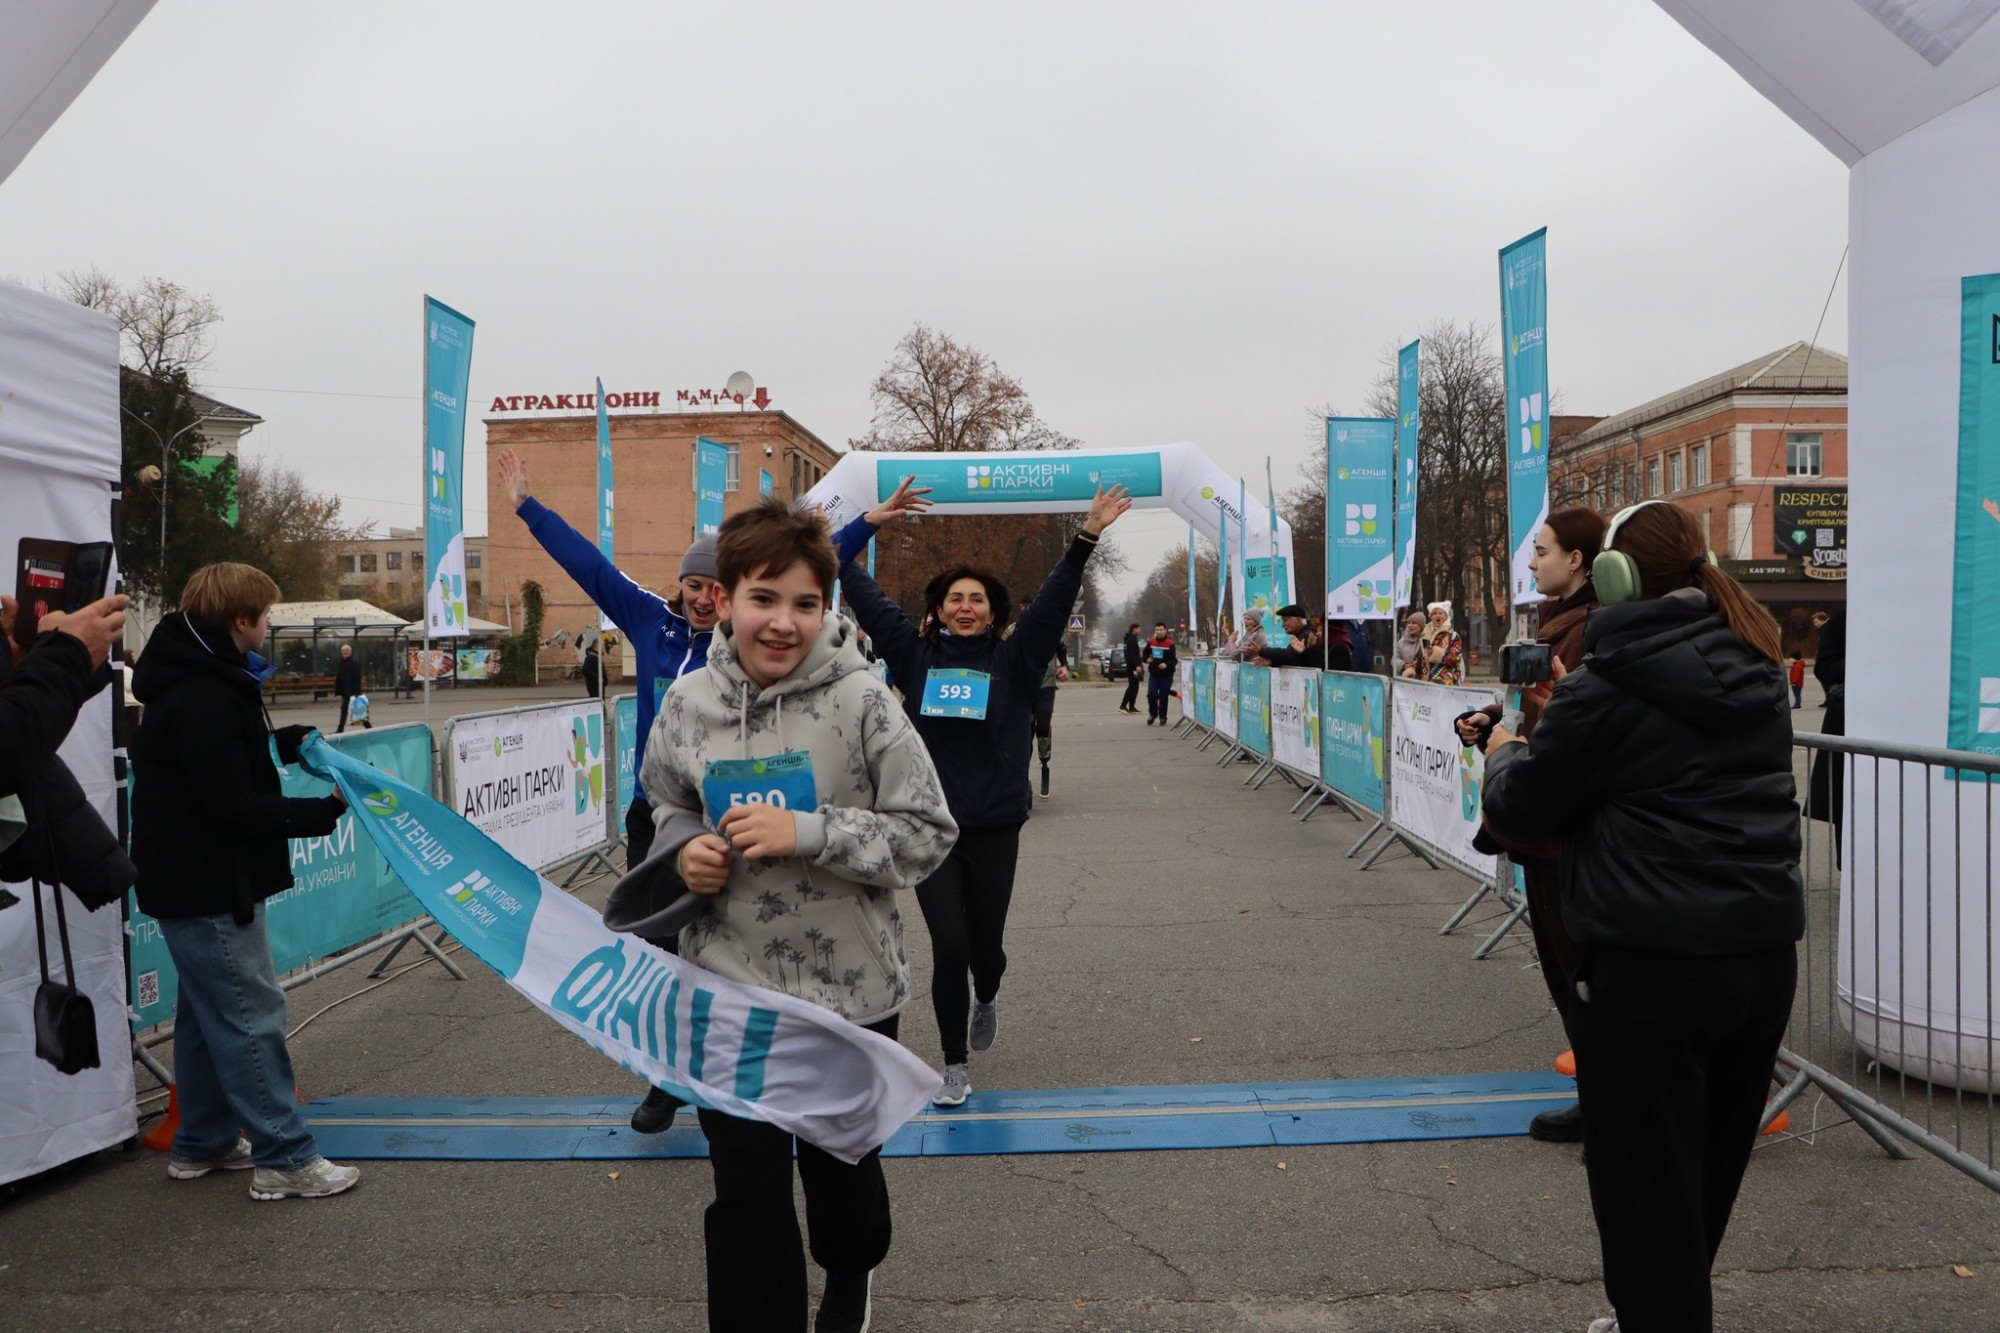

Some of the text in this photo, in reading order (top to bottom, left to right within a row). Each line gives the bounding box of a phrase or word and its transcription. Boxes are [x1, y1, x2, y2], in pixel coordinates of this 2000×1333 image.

[490, 392, 660, 412] АТРАКЦОНИ
[993, 464, 1070, 476] АКТИВНІ
[1351, 468, 1387, 477] АГЕНЦІЯ
[993, 476, 1053, 488] ПАРКИ
[1214, 495, 1247, 523] АГЕНЦІ
[1797, 519, 1847, 527] КРИПТОВАЛЮ
[1337, 537, 1387, 545] АКТИВНІ ПАРКИ
[938, 684, 972, 700] 593
[766, 755, 801, 768] АГЕНЦІЯ
[464, 764, 565, 819] АКТИВНІ ПАРКИ
[291, 816, 355, 869] АРКИ
[390, 811, 454, 871] АГЕНЦІЯ
[307, 861, 356, 892] УКРАЇНИ
[482, 884, 523, 916] АКТИВНІ
[463, 897, 498, 928] ПАРКИ
